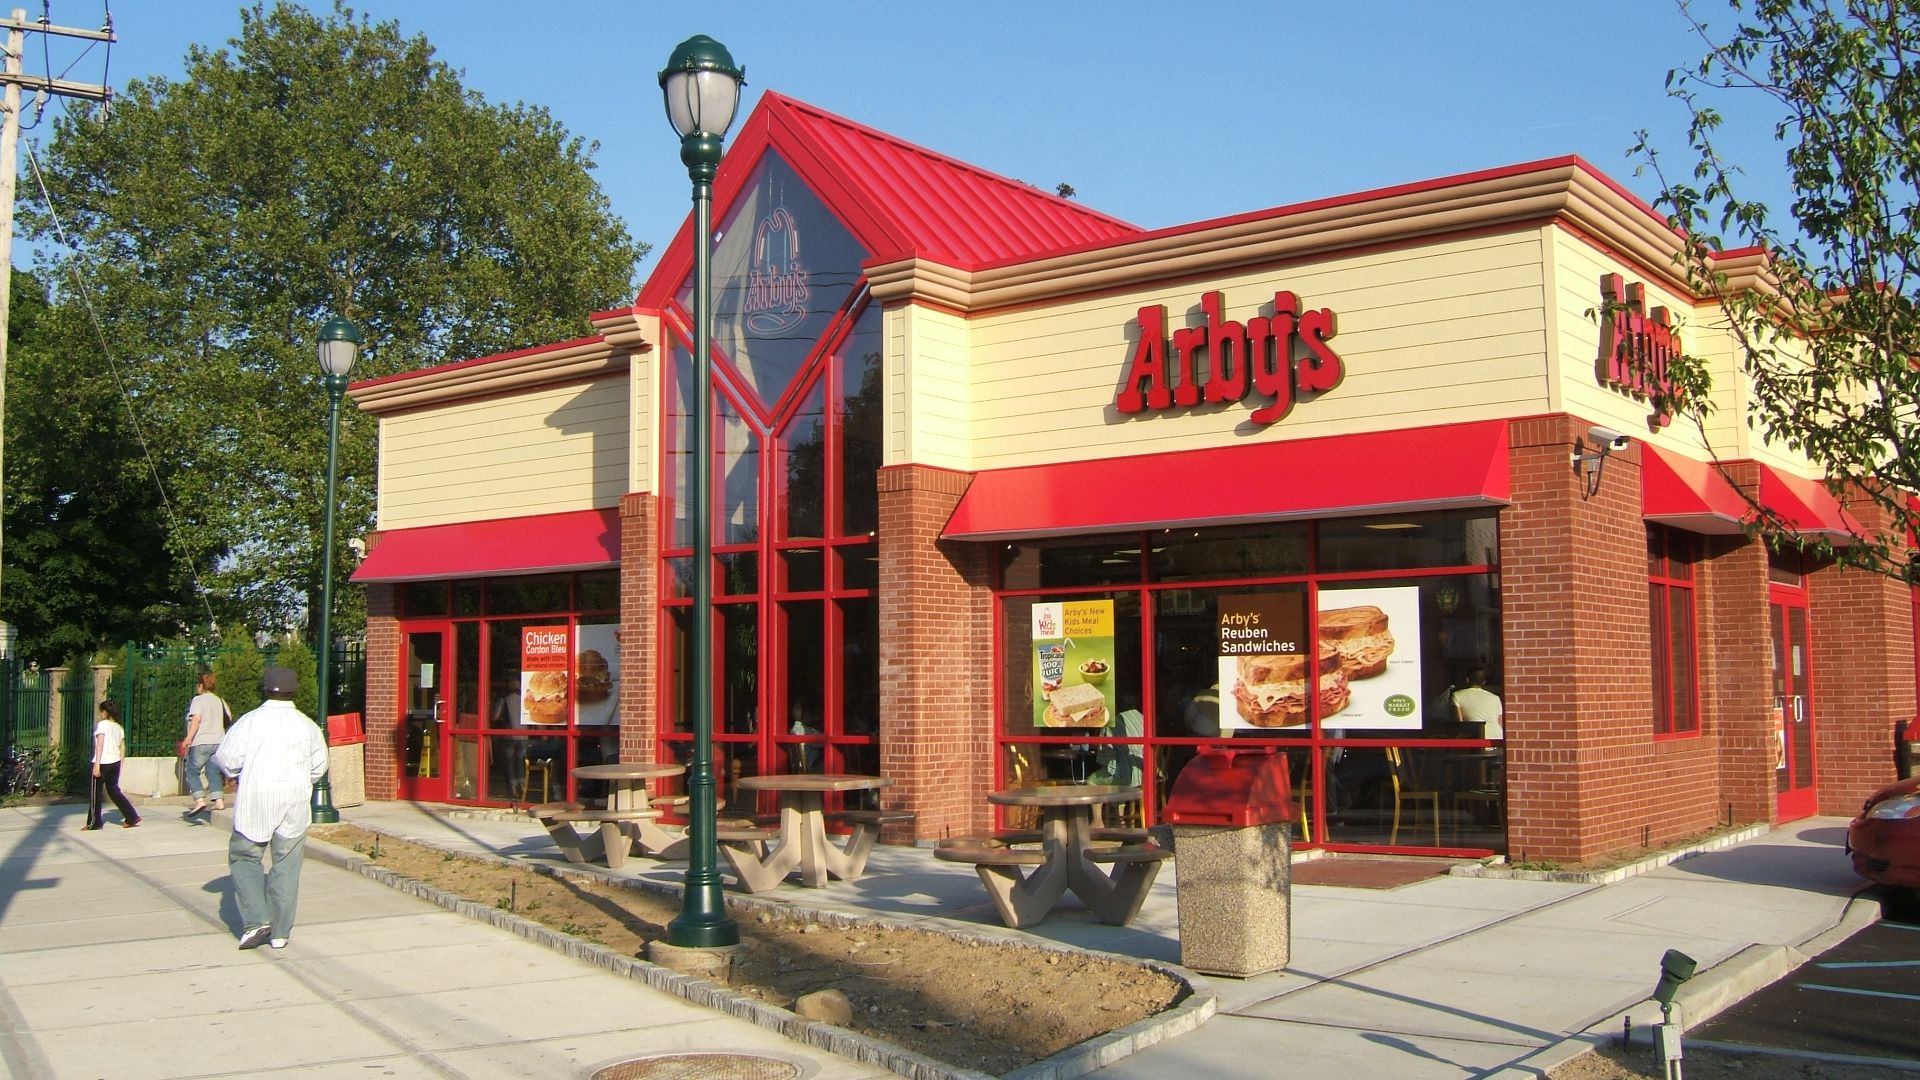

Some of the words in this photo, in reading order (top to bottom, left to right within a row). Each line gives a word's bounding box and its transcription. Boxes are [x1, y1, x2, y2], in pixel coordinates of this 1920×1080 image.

[745, 262, 808, 316] Arby's
[1117, 291, 1340, 424] Arby's
[1064, 608, 1088, 617] Arby's
[1082, 617, 1099, 625] Meal
[1221, 612, 1260, 627] Arby's
[526, 631, 567, 645] Chicken
[1221, 627, 1268, 639] Reuben
[526, 645, 550, 654] Cordon
[551, 645, 567, 654] Bleu
[1221, 640, 1296, 653] Sandwiches
[1039, 651, 1064, 660] Tropicana
